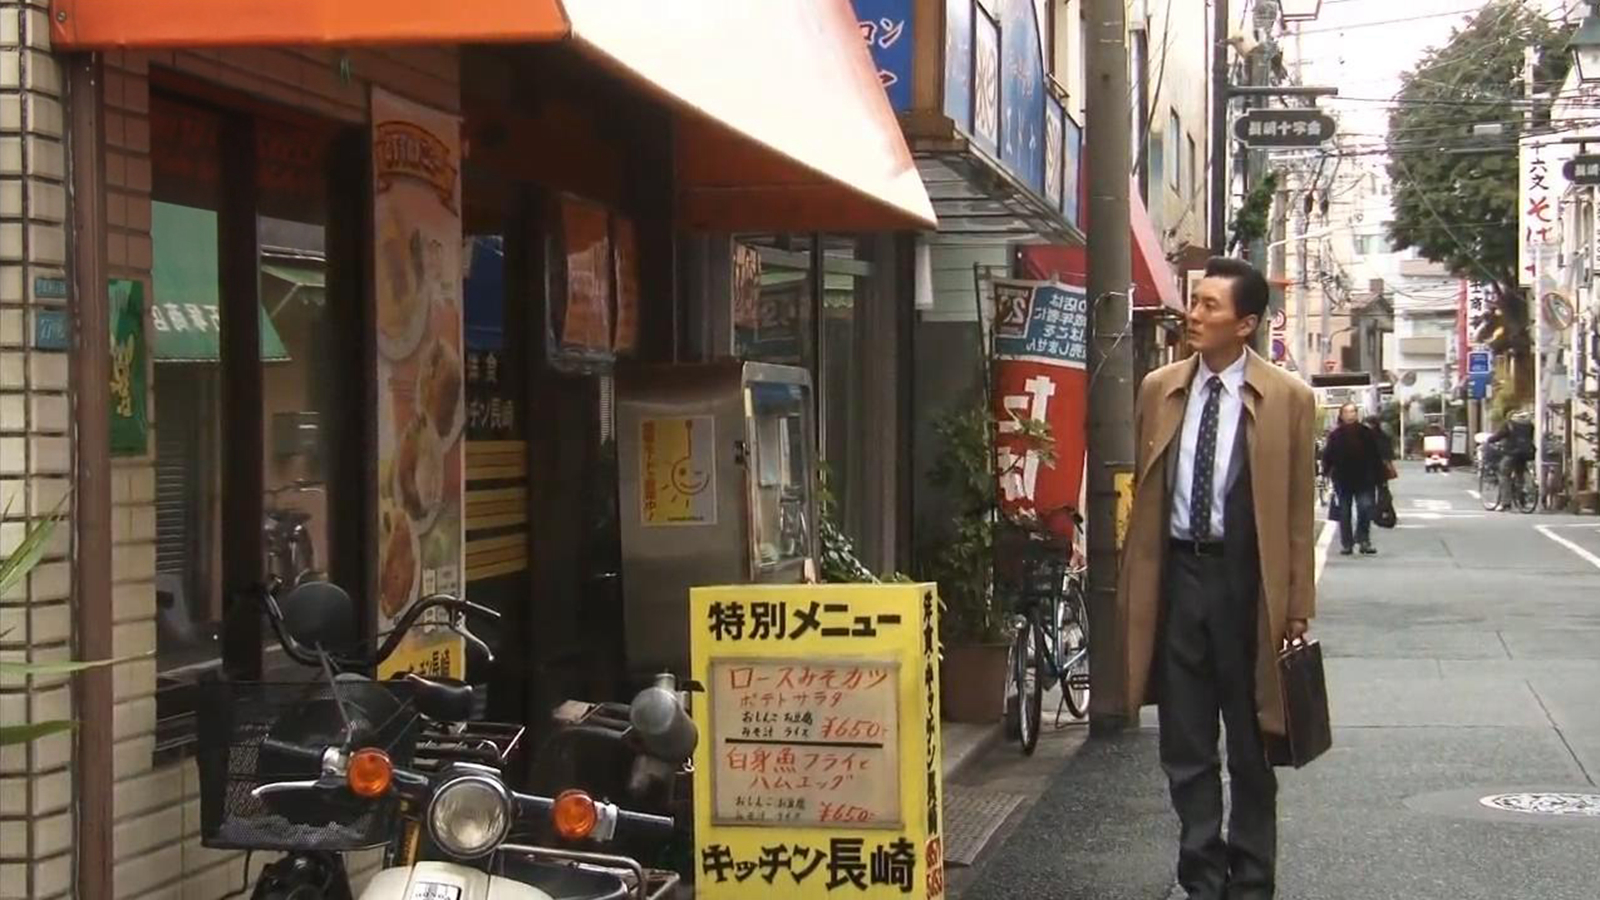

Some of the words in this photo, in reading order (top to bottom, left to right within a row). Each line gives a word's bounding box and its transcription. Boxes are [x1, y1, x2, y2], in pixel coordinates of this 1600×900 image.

[708, 601, 902, 640] 特別メニュー
[730, 666, 888, 690] ロースみそカツ
[726, 747, 871, 773] 白身魚フライと
[749, 774, 853, 791] ハムエッグ
[702, 838, 916, 894] キッチン長崎
